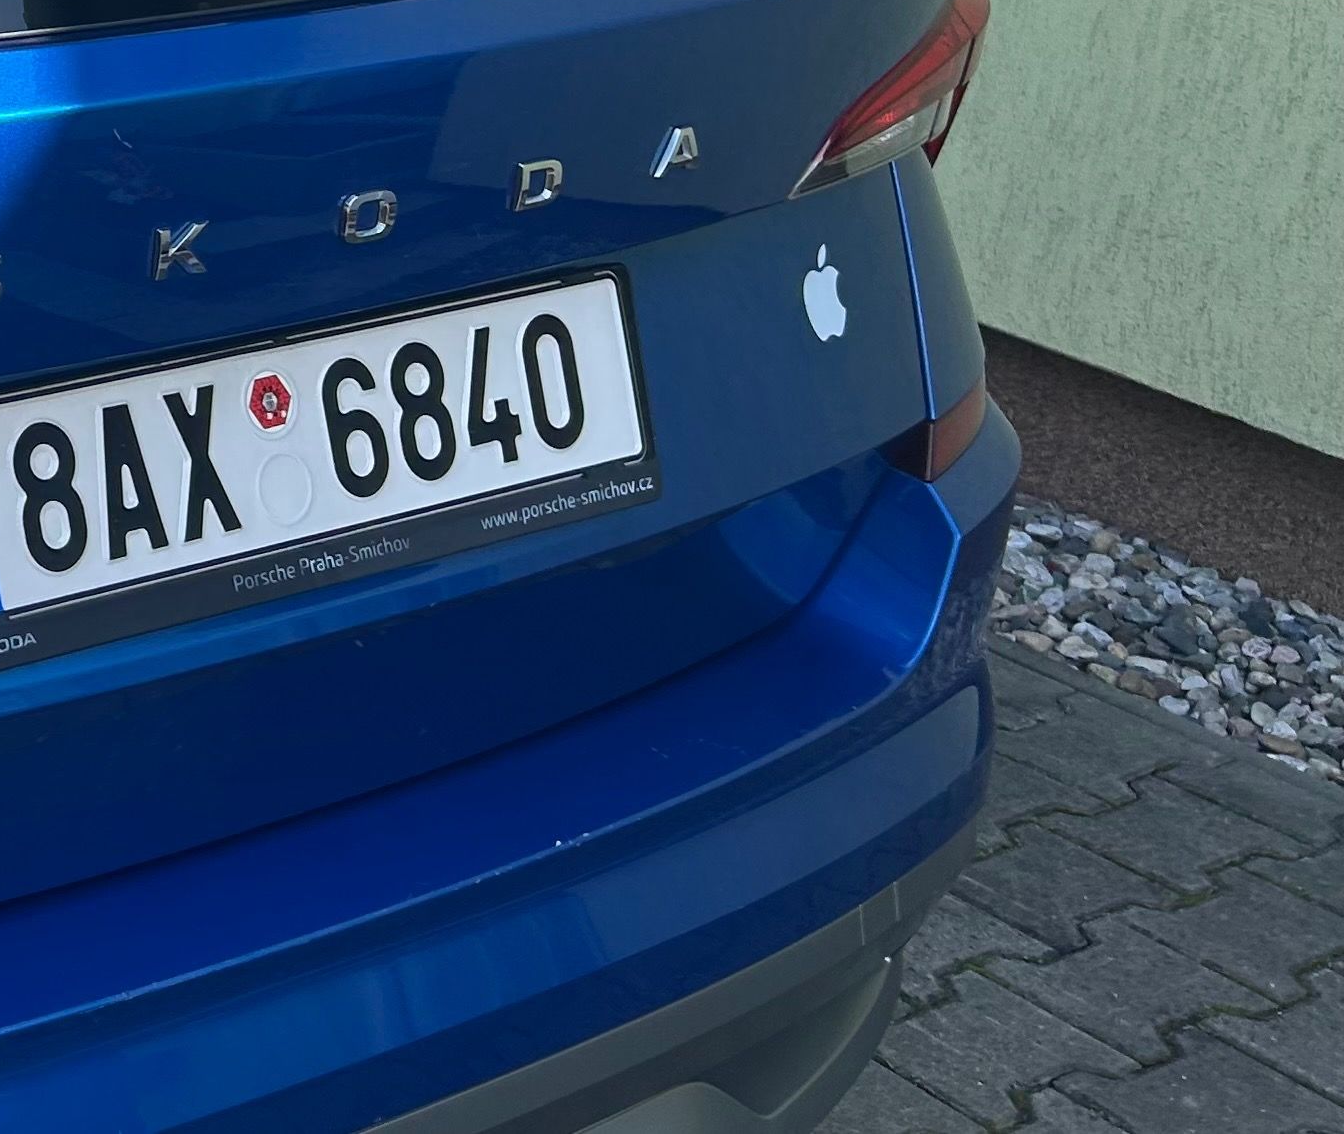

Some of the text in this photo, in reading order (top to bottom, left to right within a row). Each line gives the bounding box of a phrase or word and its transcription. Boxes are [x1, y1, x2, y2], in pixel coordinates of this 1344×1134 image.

[12, 313, 585, 573] 8AX 6840
[479, 475, 655, 531] www.porsche-smichov.cz
[232, 563, 297, 593] Porsche
